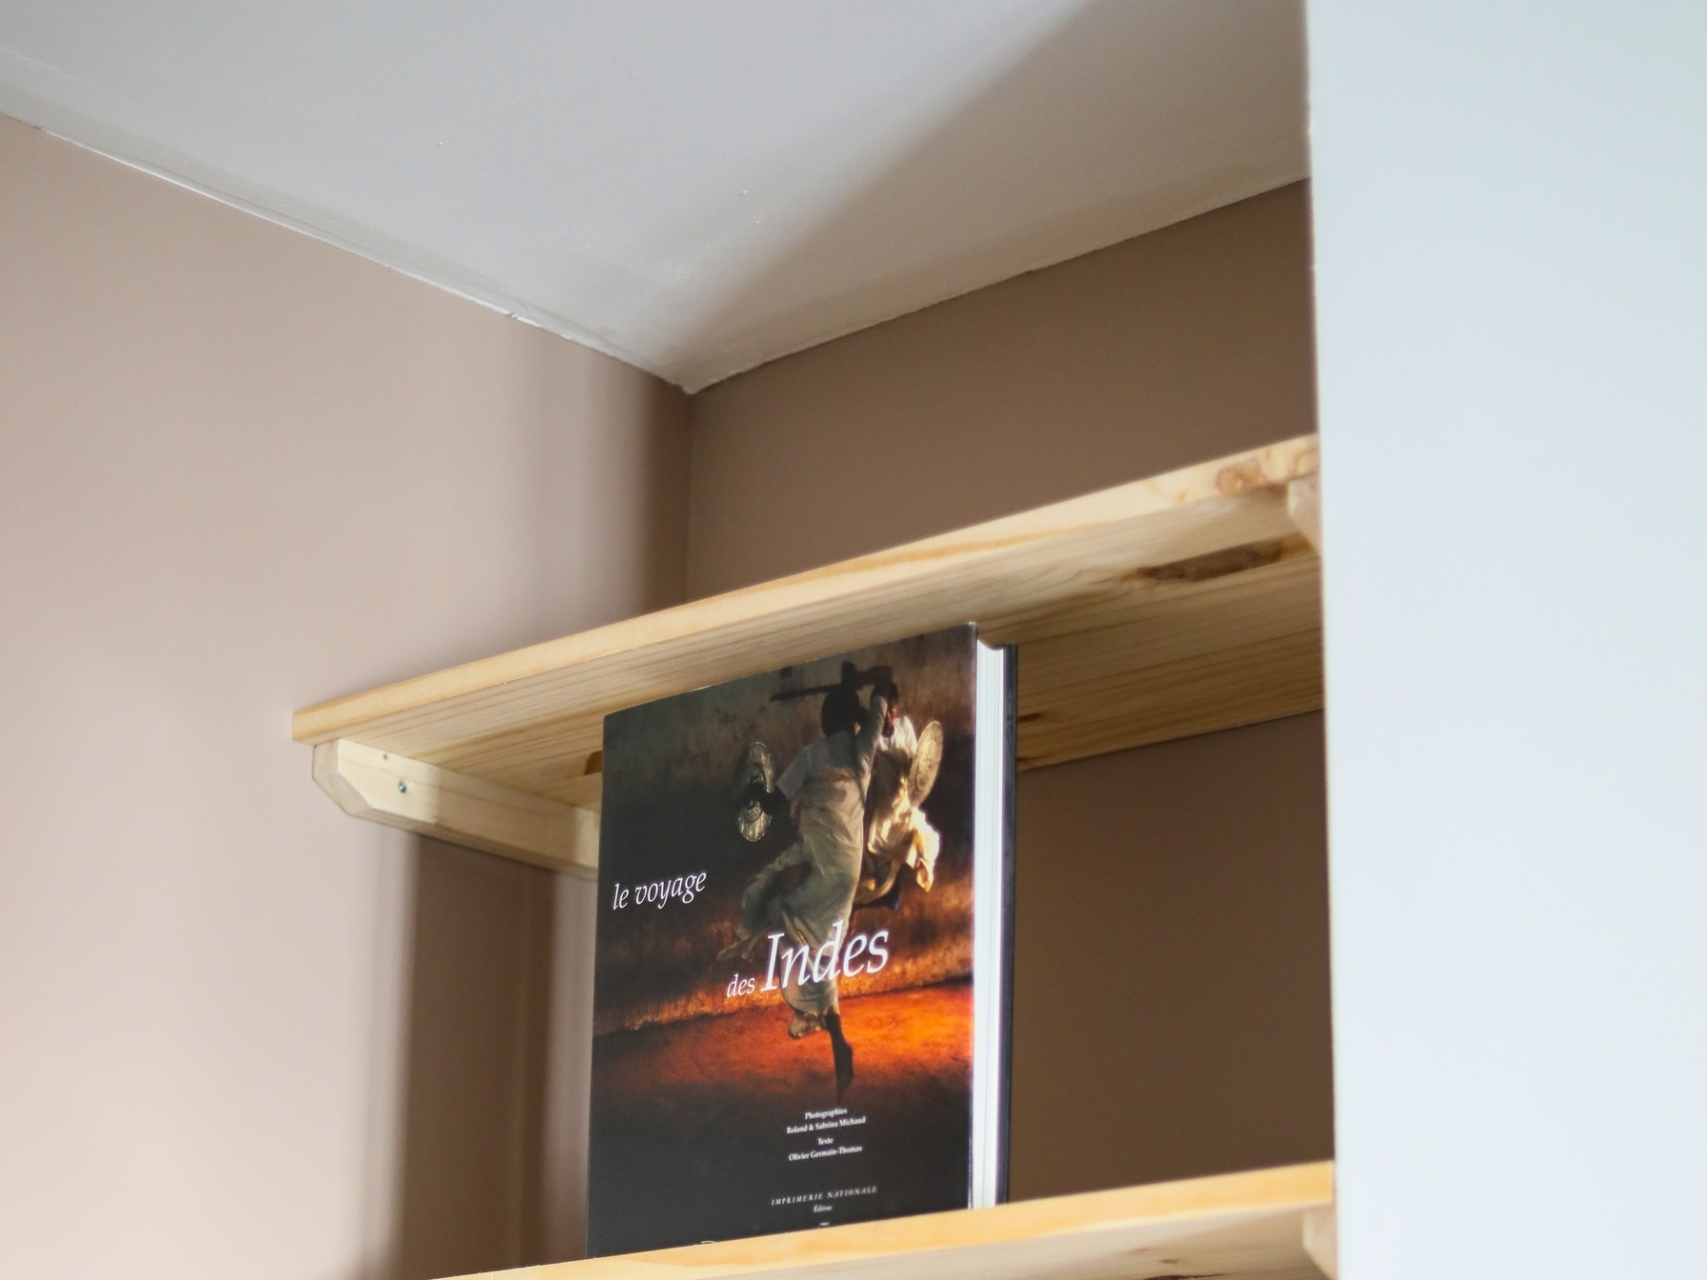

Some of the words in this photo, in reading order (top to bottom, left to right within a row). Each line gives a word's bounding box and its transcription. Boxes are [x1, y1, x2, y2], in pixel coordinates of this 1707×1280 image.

[612, 882, 629, 910] le
[634, 871, 708, 910] voyage
[726, 973, 756, 998] des
[760, 919, 890, 992] Indes
[804, 1106, 848, 1120] Photographies
[786, 1124, 808, 1134] Roland
[815, 1120, 839, 1131] Sabrina
[839, 1116, 866, 1127] Michaud
[817, 1137, 834, 1146] Texte
[788, 1152, 810, 1162] Olivier
[810, 1145, 863, 1159] Germain-Thomas
[771, 1192, 824, 1207] IMPRIMERIE
[827, 1185, 878, 1199] NATIONALE
